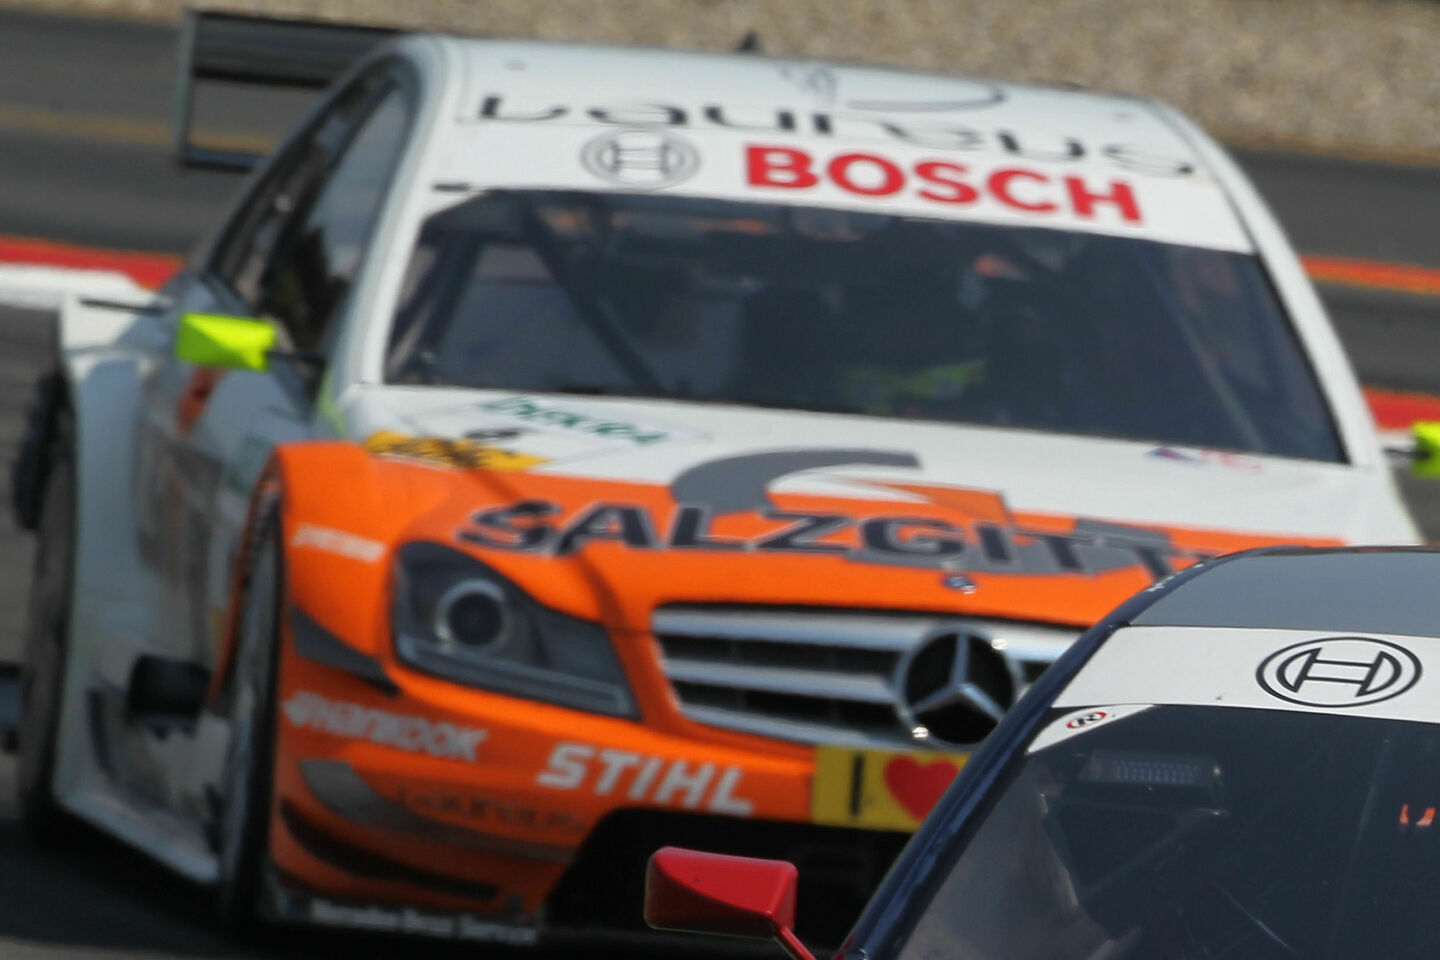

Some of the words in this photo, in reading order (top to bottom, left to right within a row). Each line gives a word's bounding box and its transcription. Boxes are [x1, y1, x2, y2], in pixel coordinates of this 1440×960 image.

[743, 142, 1143, 224] BOSCH
[454, 498, 1180, 580] SALZGITT
[535, 741, 753, 818] STIHL
